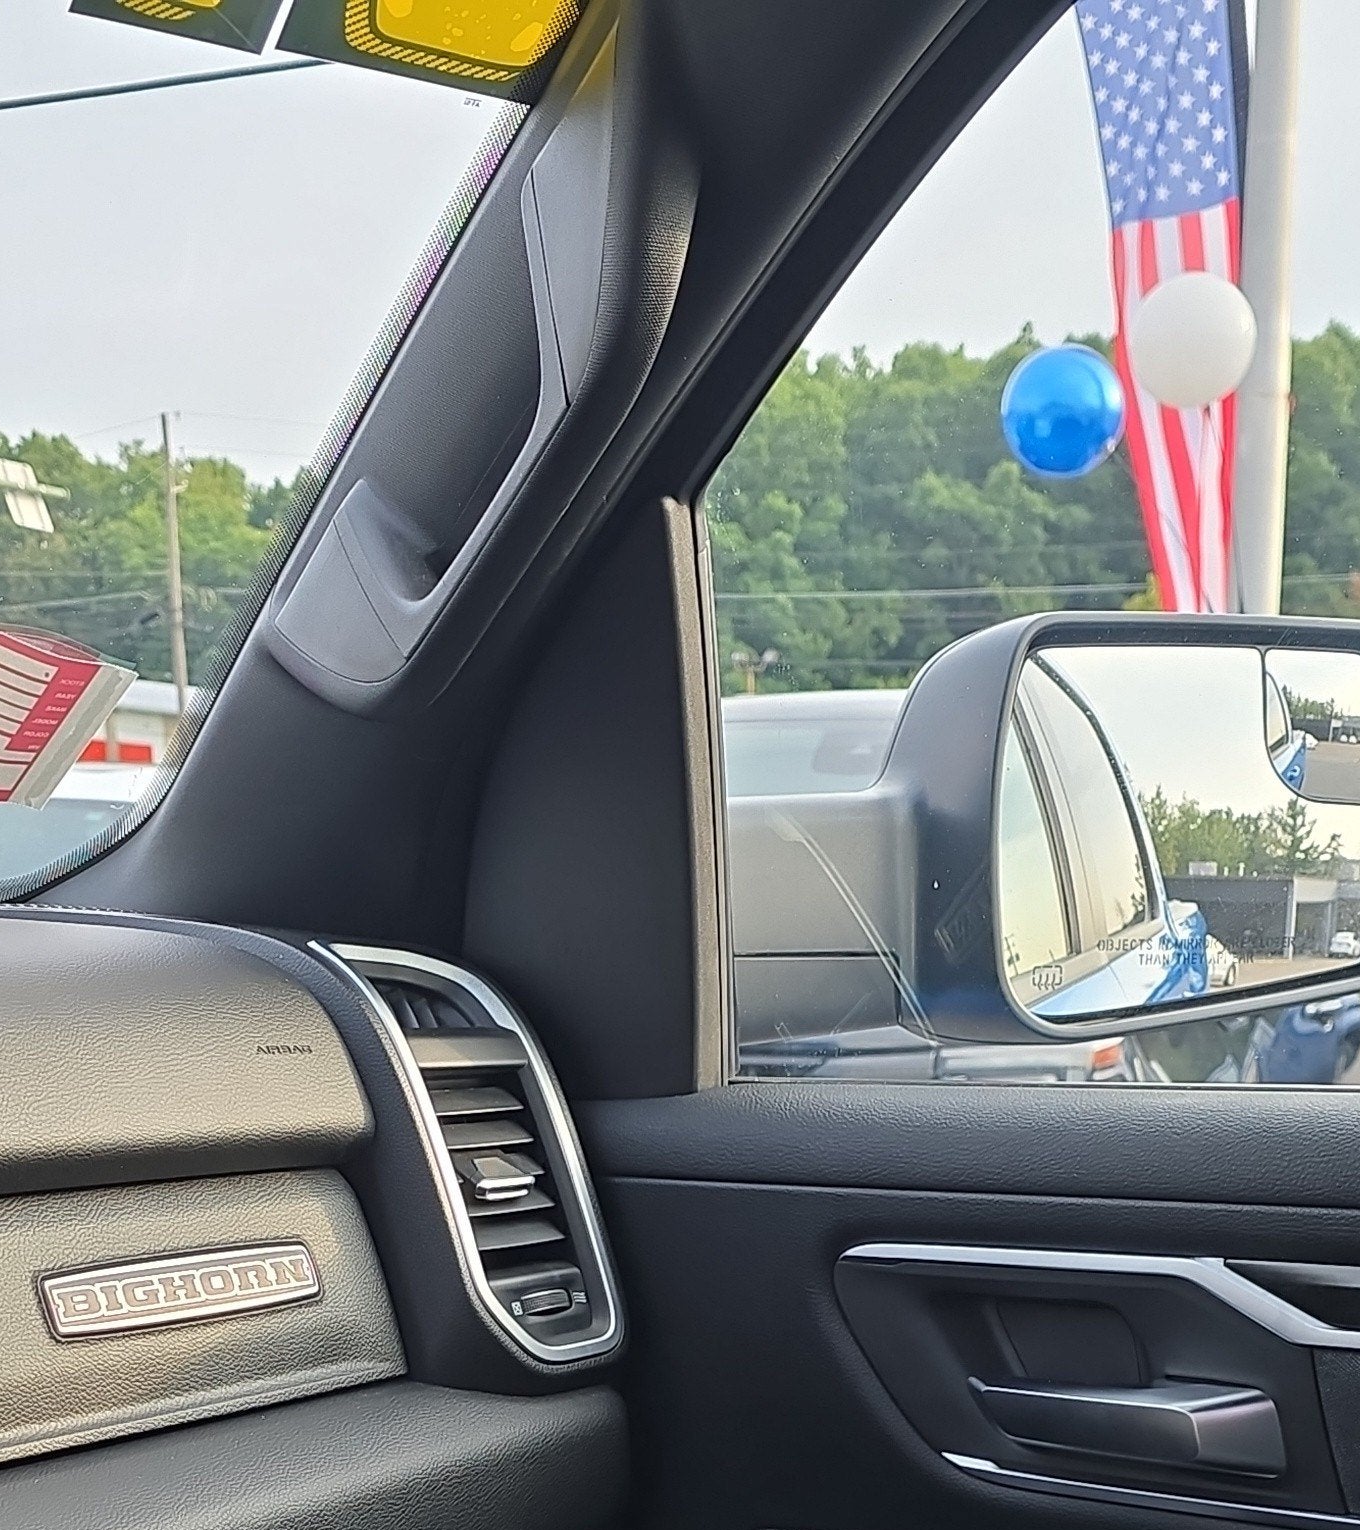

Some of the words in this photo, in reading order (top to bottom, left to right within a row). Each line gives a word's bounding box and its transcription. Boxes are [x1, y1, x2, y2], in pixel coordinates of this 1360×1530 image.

[1097, 938, 1153, 951] OBJECTS
[1174, 937, 1218, 950] MIRROR
[1139, 953, 1170, 965] THAN
[1177, 953, 1204, 965] THEY
[255, 1044, 313, 1055] AIRBAG
[52, 1256, 311, 1322] BIGHORN
